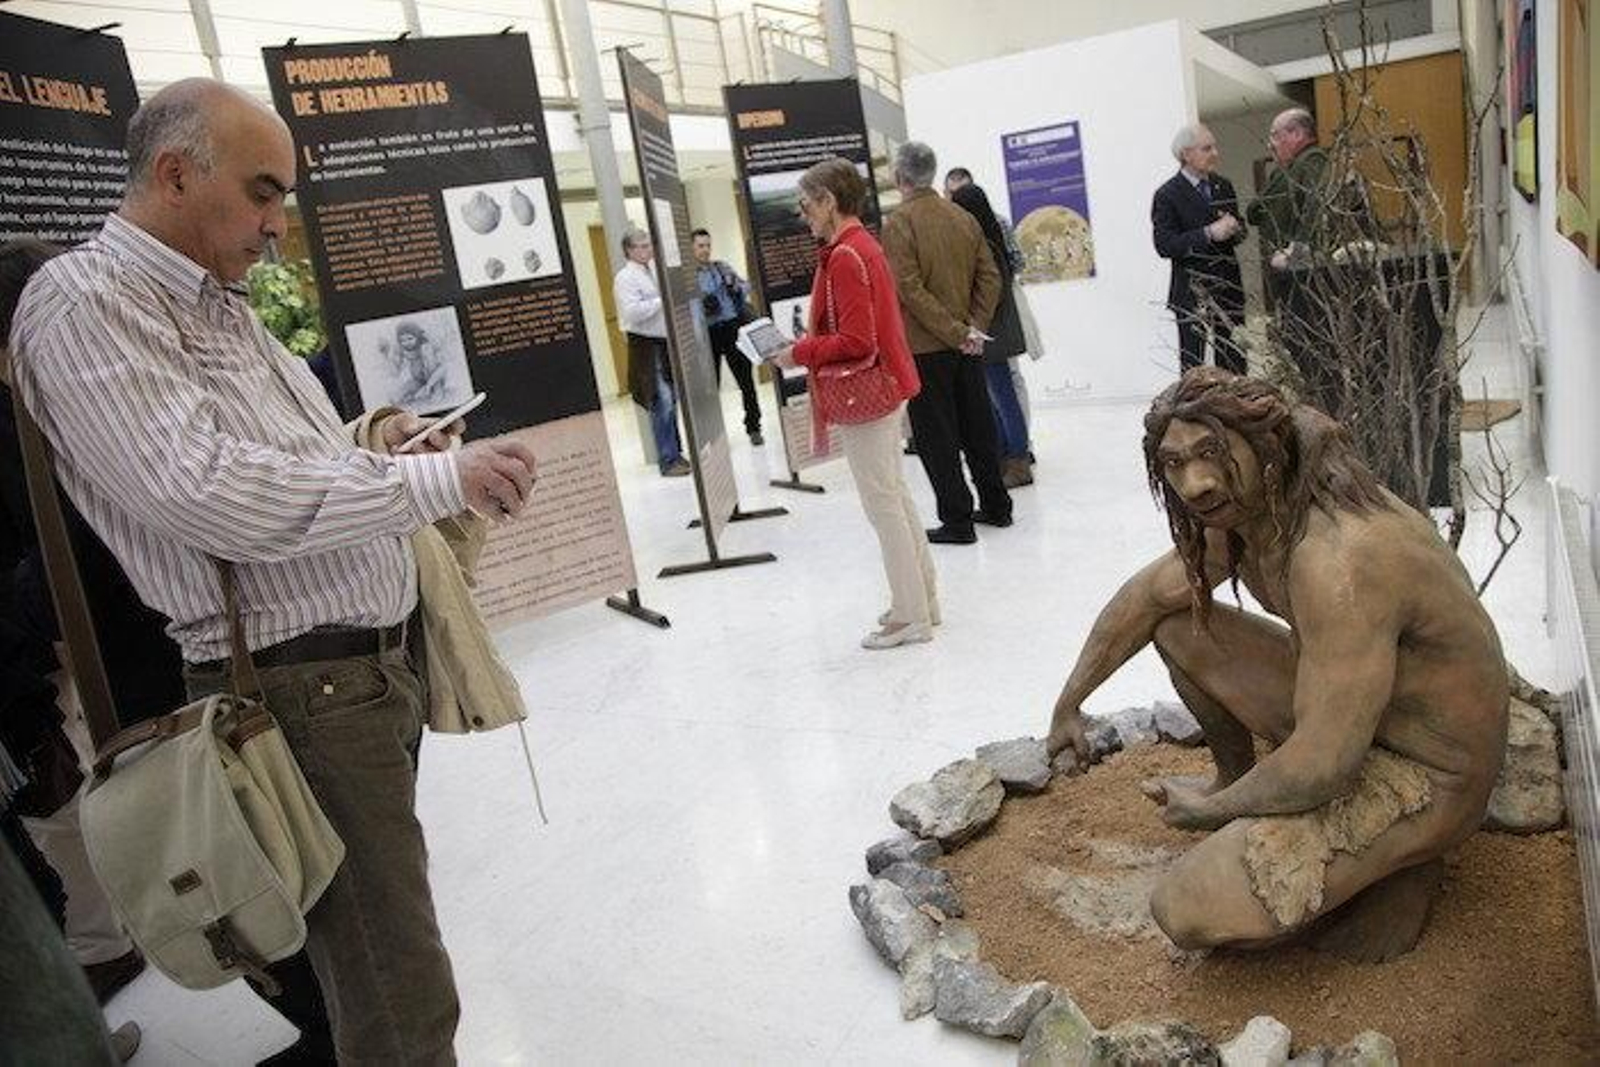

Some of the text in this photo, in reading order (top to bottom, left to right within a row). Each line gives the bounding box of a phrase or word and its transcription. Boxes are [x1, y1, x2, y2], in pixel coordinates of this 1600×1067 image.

[284, 50, 392, 84] PRODUCCIÓN
[21, 74, 111, 117] LENGUAJE
[292, 81, 448, 116] DE HERRAMIENTAS
